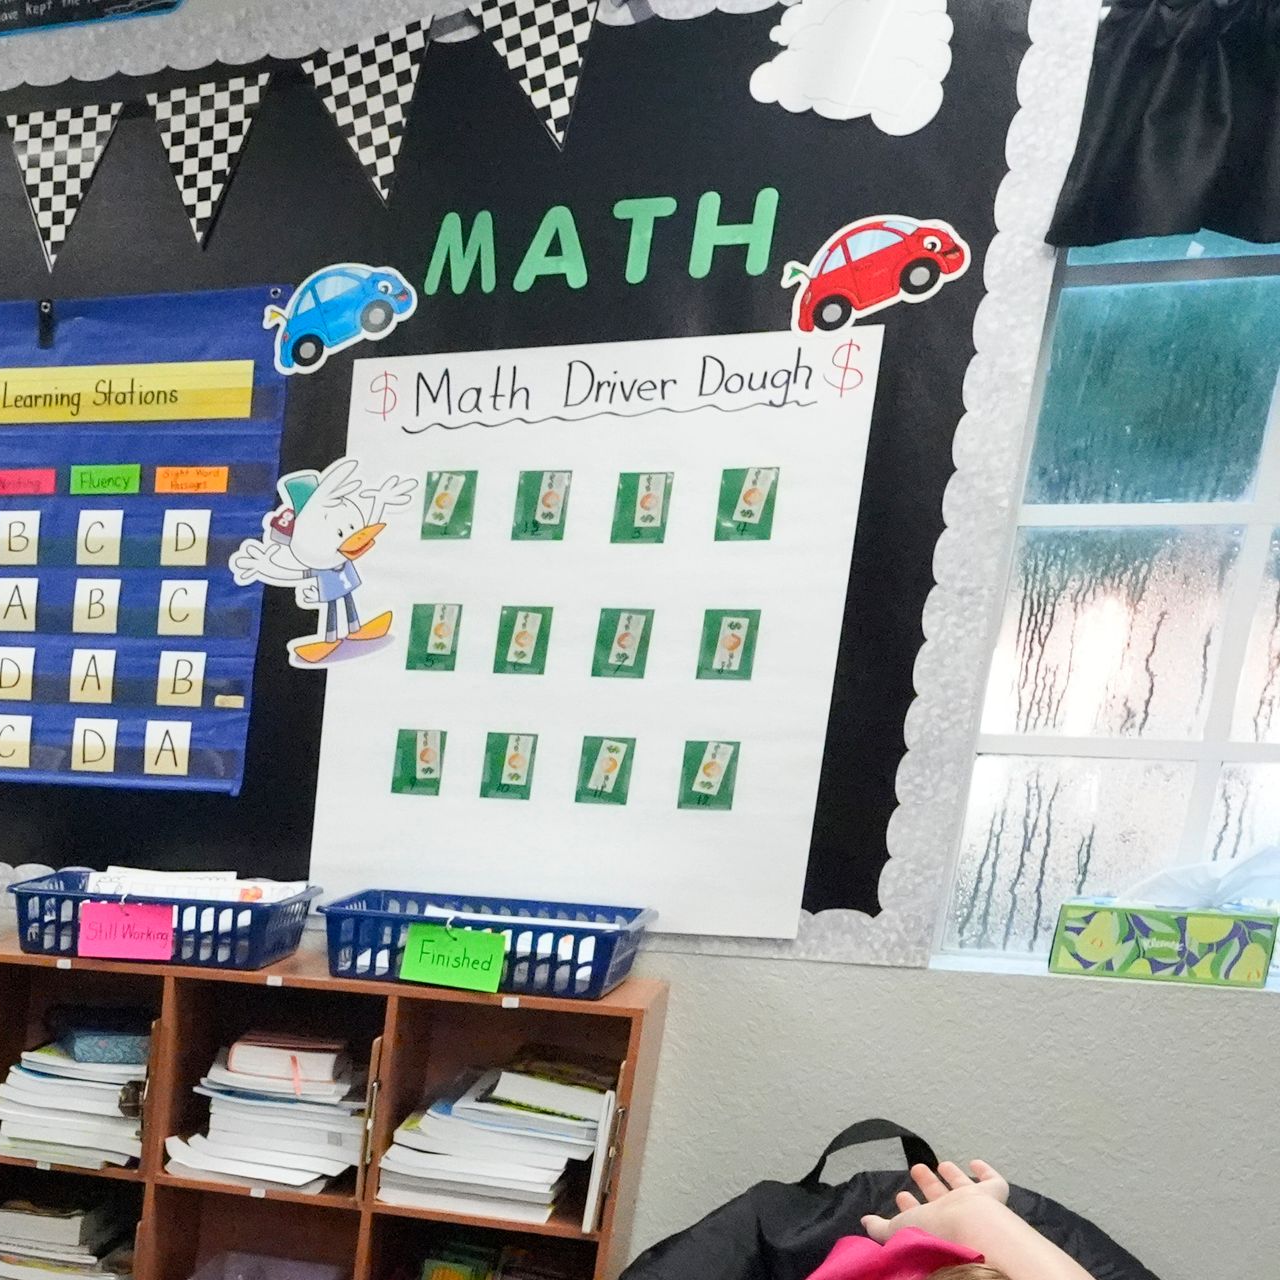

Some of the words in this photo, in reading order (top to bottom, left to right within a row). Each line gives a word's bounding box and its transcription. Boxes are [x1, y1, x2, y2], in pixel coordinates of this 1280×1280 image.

[423, 187, 780, 295] MATH
[2, 381, 83, 417] Learning
[92, 378, 179, 408] Stations
[415, 364, 531, 417] Math
[564, 359, 678, 408] Driver
[697, 346, 815, 409] Dough
[80, 471, 131, 490] Fluency
[9, 520, 30, 552] B
[84, 520, 106, 554] C
[174, 522, 197, 553] D
[3, 584, 28, 621] A
[88, 588, 106, 619] B
[168, 587, 191, 623] C
[81, 654, 102, 692] A
[171, 659, 194, 695] B
[83, 728, 107, 764] D
[154, 729, 179, 768] A
[85, 920, 119, 942] Still
[121, 923, 170, 951] Working
[418, 939, 494, 973] Finished
